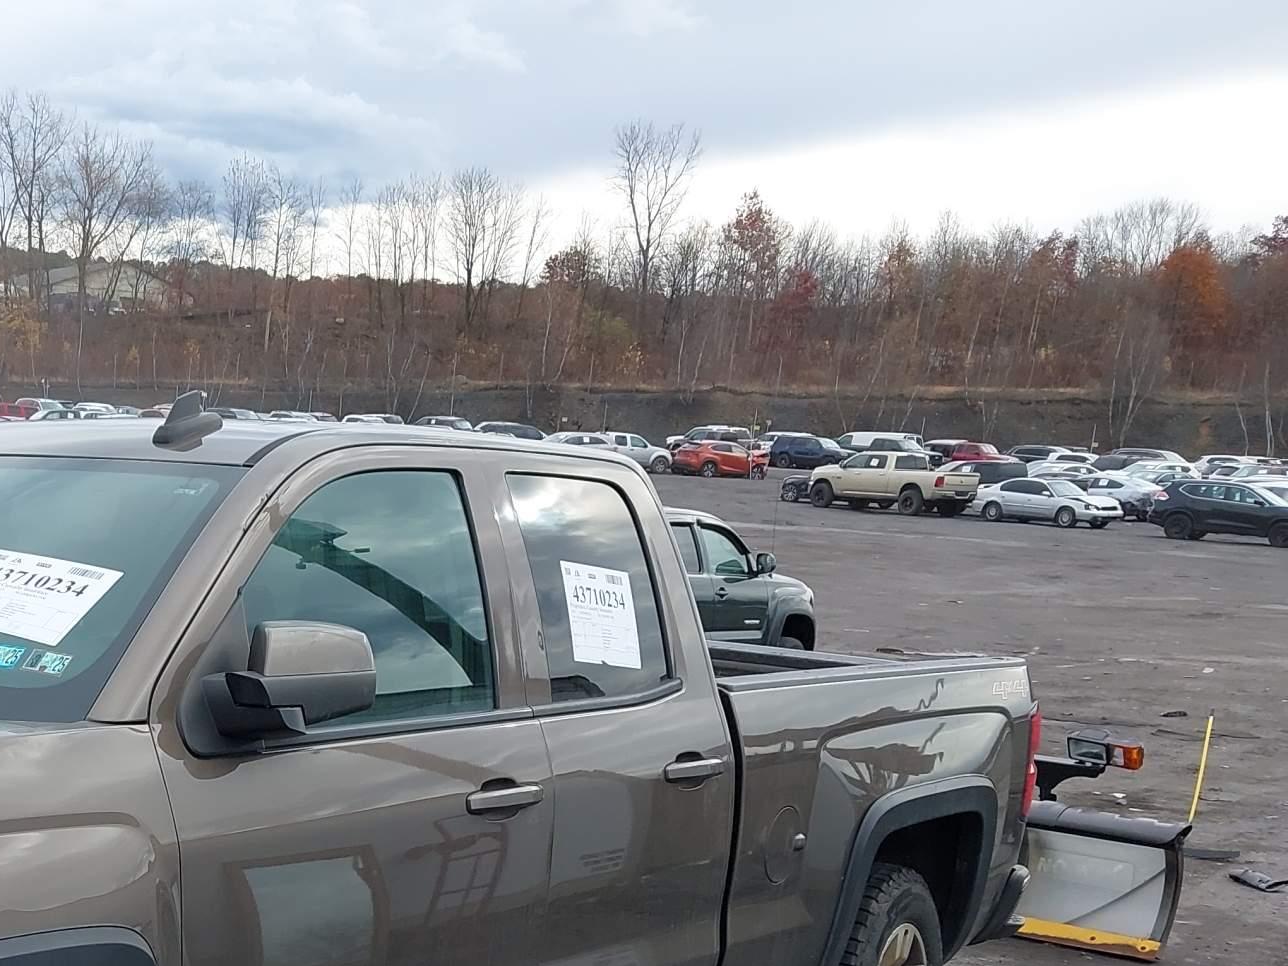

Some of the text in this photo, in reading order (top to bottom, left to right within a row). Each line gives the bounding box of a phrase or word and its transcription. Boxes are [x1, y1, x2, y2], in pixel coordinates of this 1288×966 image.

[573, 584, 626, 610] 43710234
[4, 649, 23, 665] 25
[52, 656, 70, 673] 25
